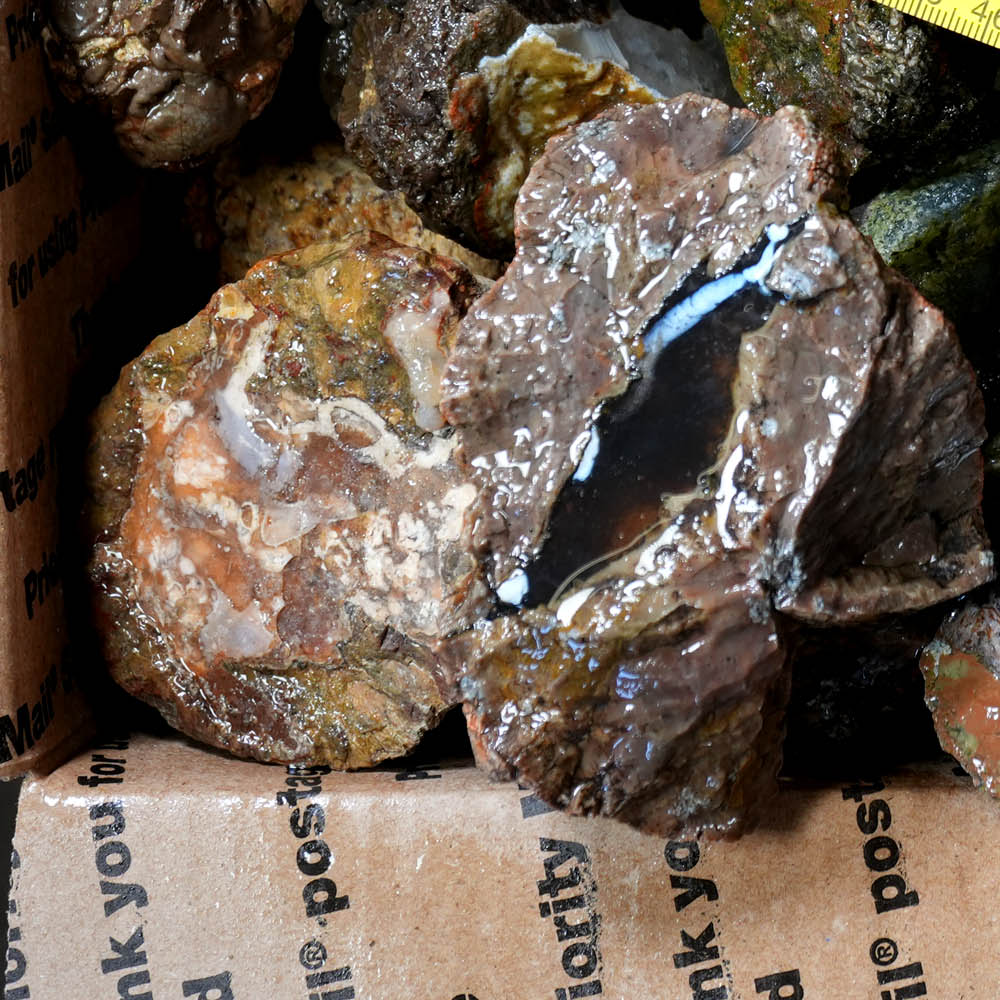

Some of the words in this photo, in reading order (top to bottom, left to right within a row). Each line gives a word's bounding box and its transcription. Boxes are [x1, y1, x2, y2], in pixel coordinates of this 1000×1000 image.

[77, 754, 128, 788] for
[89, 800, 150, 917] you
[664, 840, 719, 913] yo
